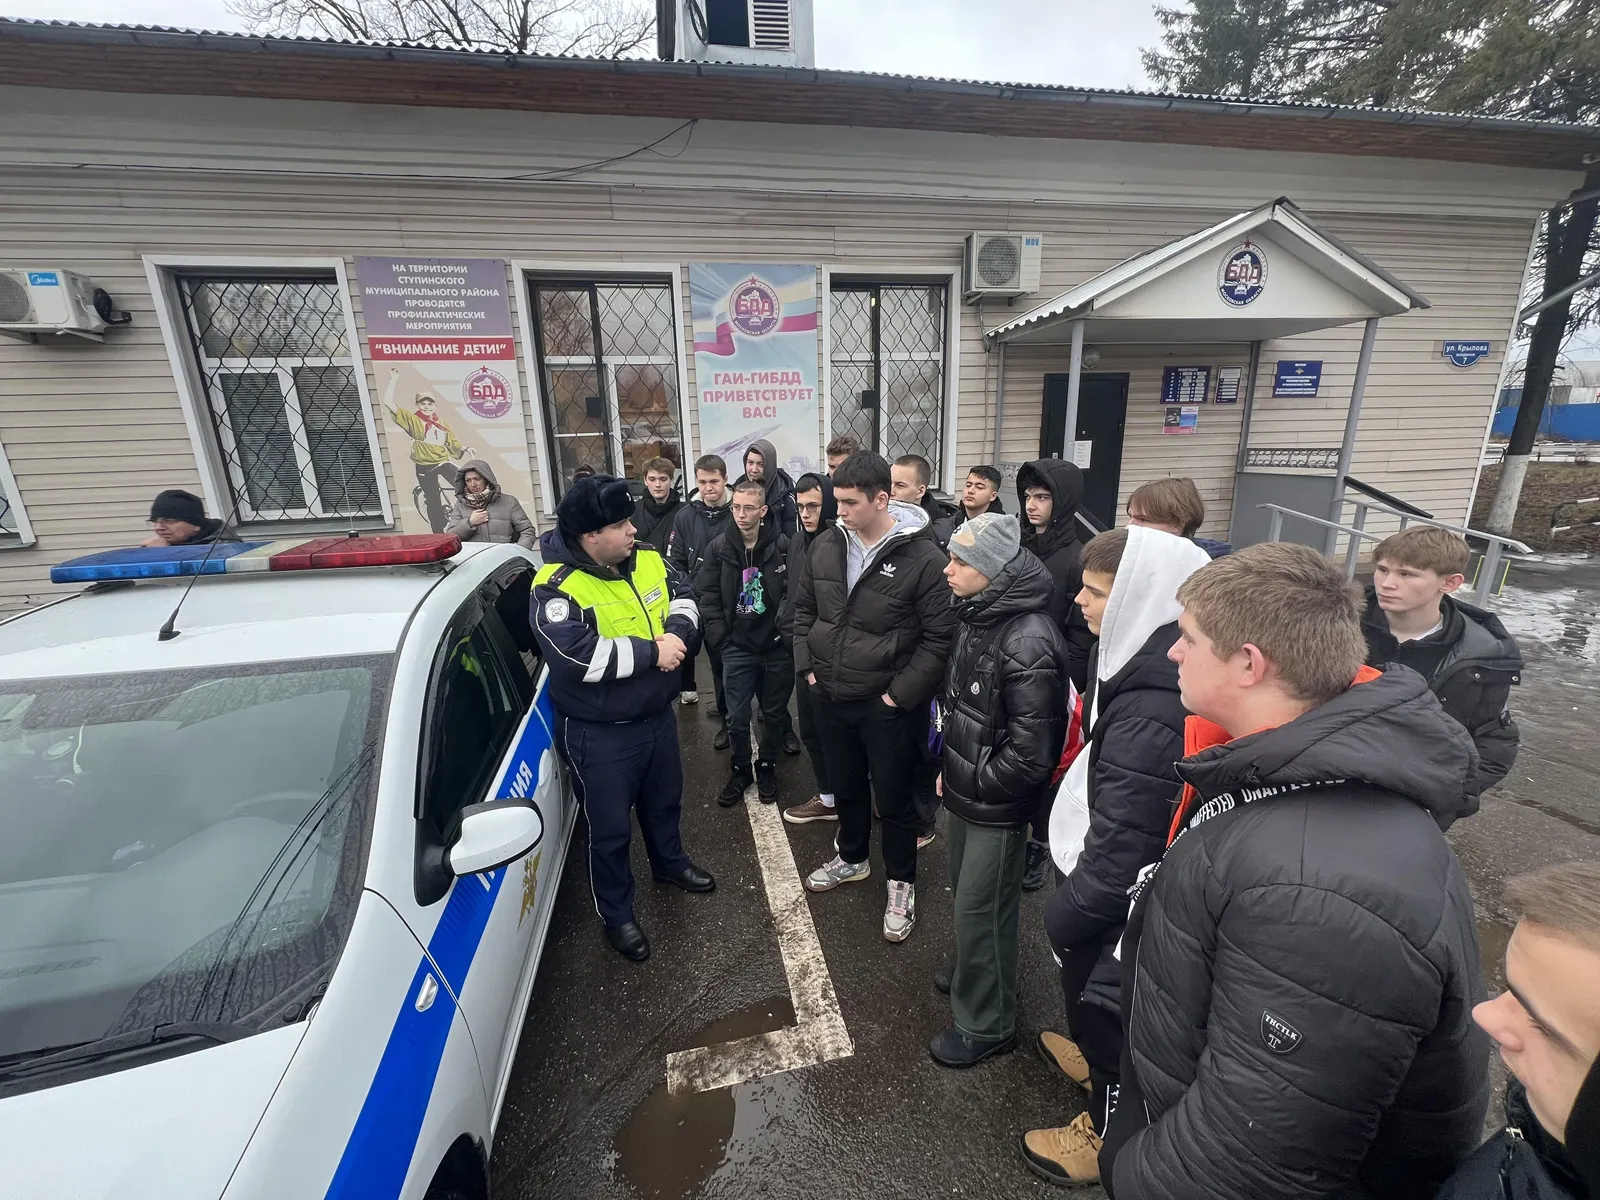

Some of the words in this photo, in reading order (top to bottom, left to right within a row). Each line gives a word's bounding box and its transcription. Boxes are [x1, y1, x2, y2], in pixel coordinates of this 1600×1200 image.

[392, 264, 406, 272] НА
[408, 264, 468, 274] ТЕРРИТОРИИ
[398, 276, 466, 285] СТУПИНСКОГО
[365, 287, 458, 296] МУНИЦИПАЛЬНОГО
[461, 287, 500, 296] РАЙОНА
[405, 300, 466, 308] ПРОВОДЯТСЯ
[738, 298, 772, 315] БДД
[388, 311, 486, 320] ПРОФИЛАКТИЧЕСКИЕ
[406, 322, 472, 331] МЕРОПРИЯТИЯ
[714, 372, 802, 386] ГАИ-ГИБДД
[471, 384, 506, 400] БДД
[703, 388, 813, 402] ПРИВЕТСТВУЕТ
[742, 406, 776, 418] ВАС!
[1266, 1014, 1298, 1040] THCTLK
